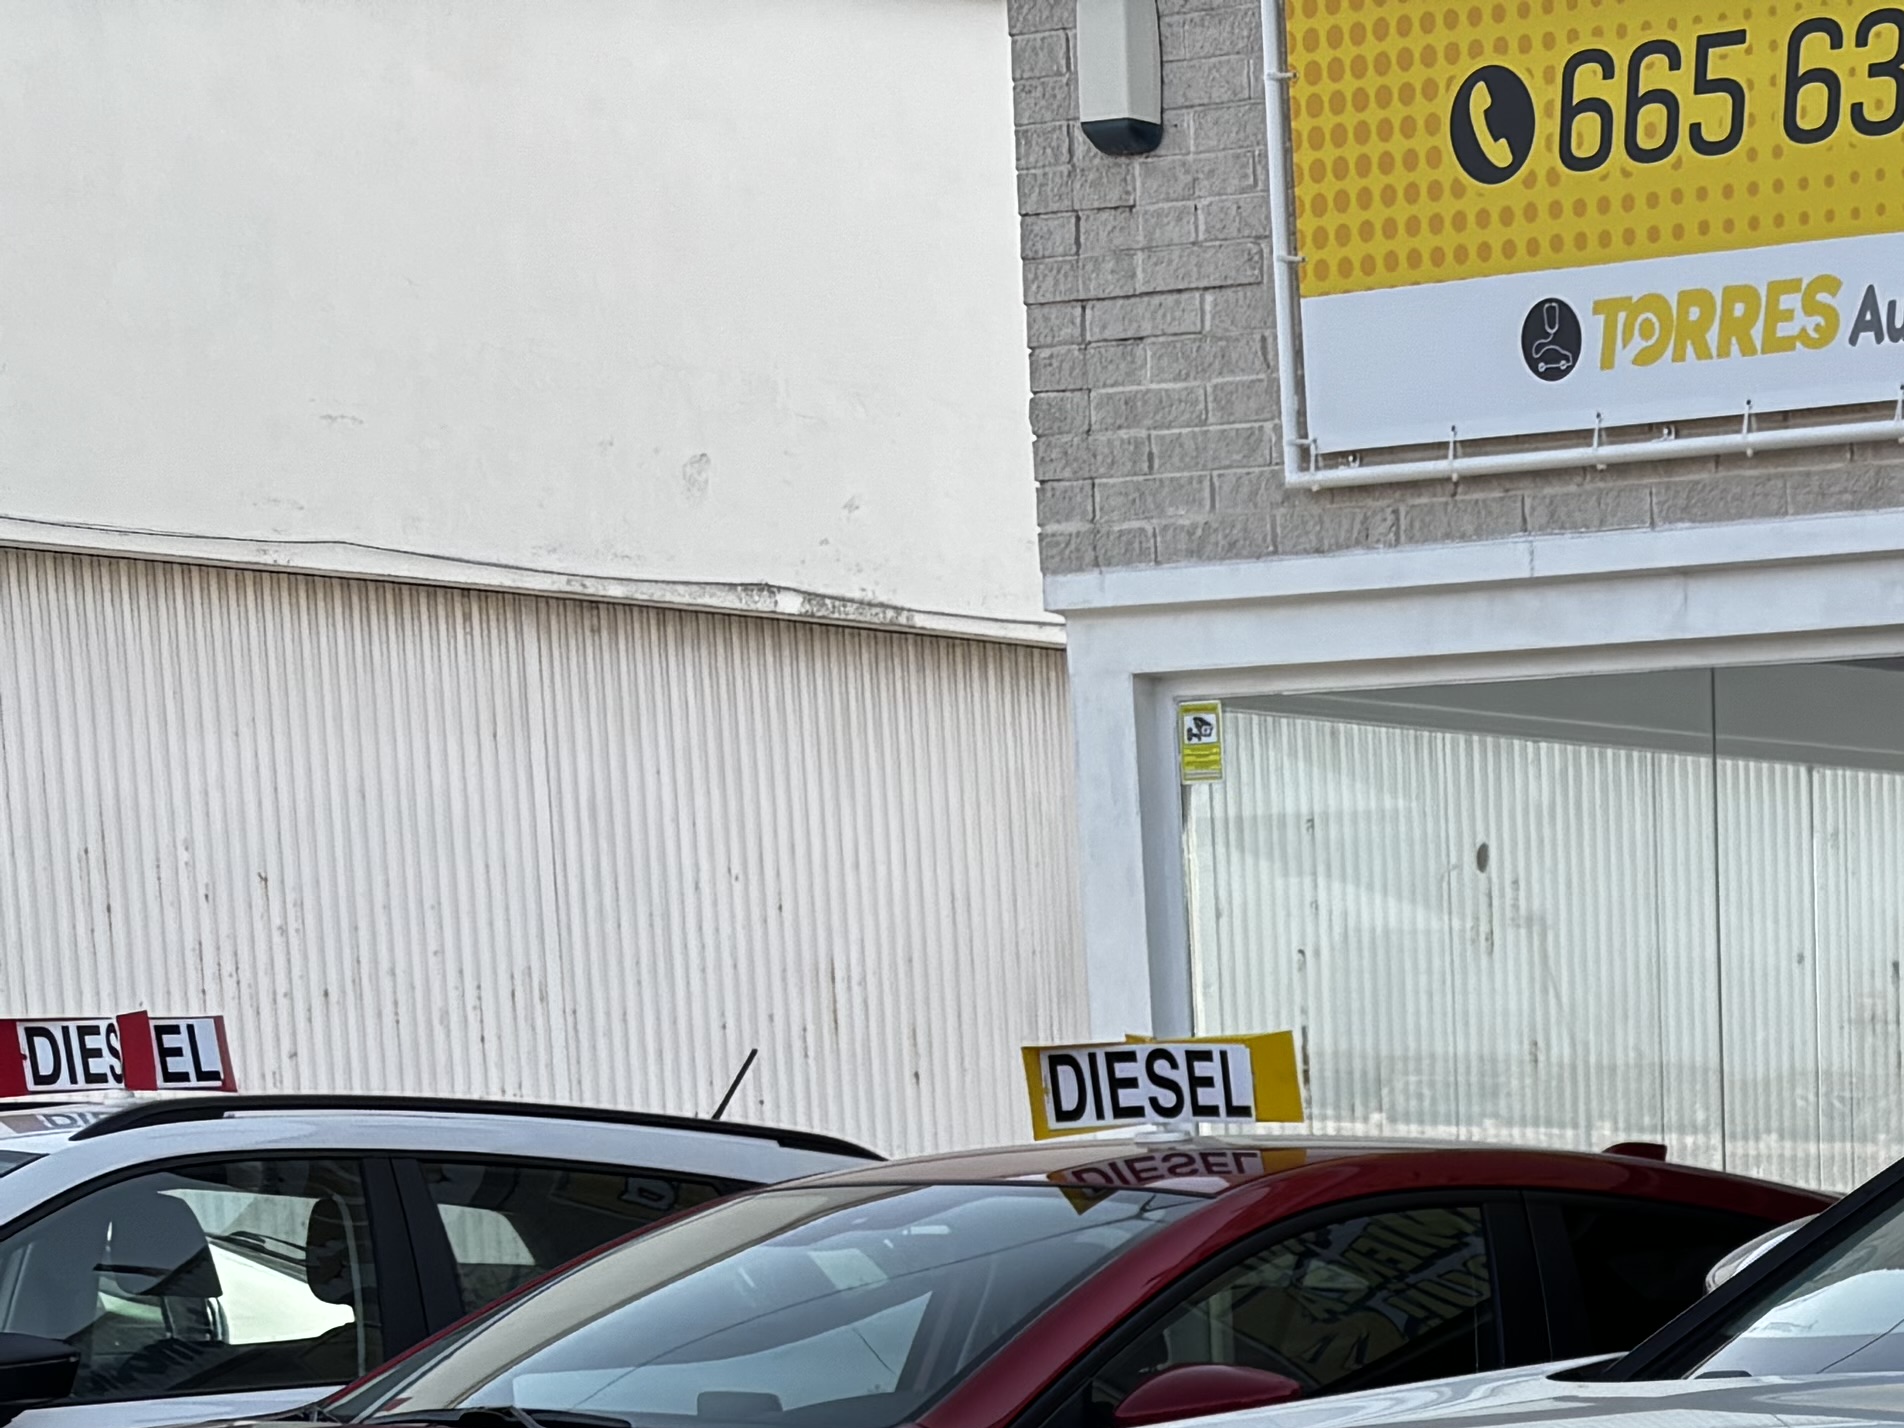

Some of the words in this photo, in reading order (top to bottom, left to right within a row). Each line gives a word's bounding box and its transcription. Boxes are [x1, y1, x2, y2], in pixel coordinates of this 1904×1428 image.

[1558, 28, 1747, 172] 665
[1593, 275, 1841, 370] TORRES
[1047, 1048, 1253, 1123] DIESEL
